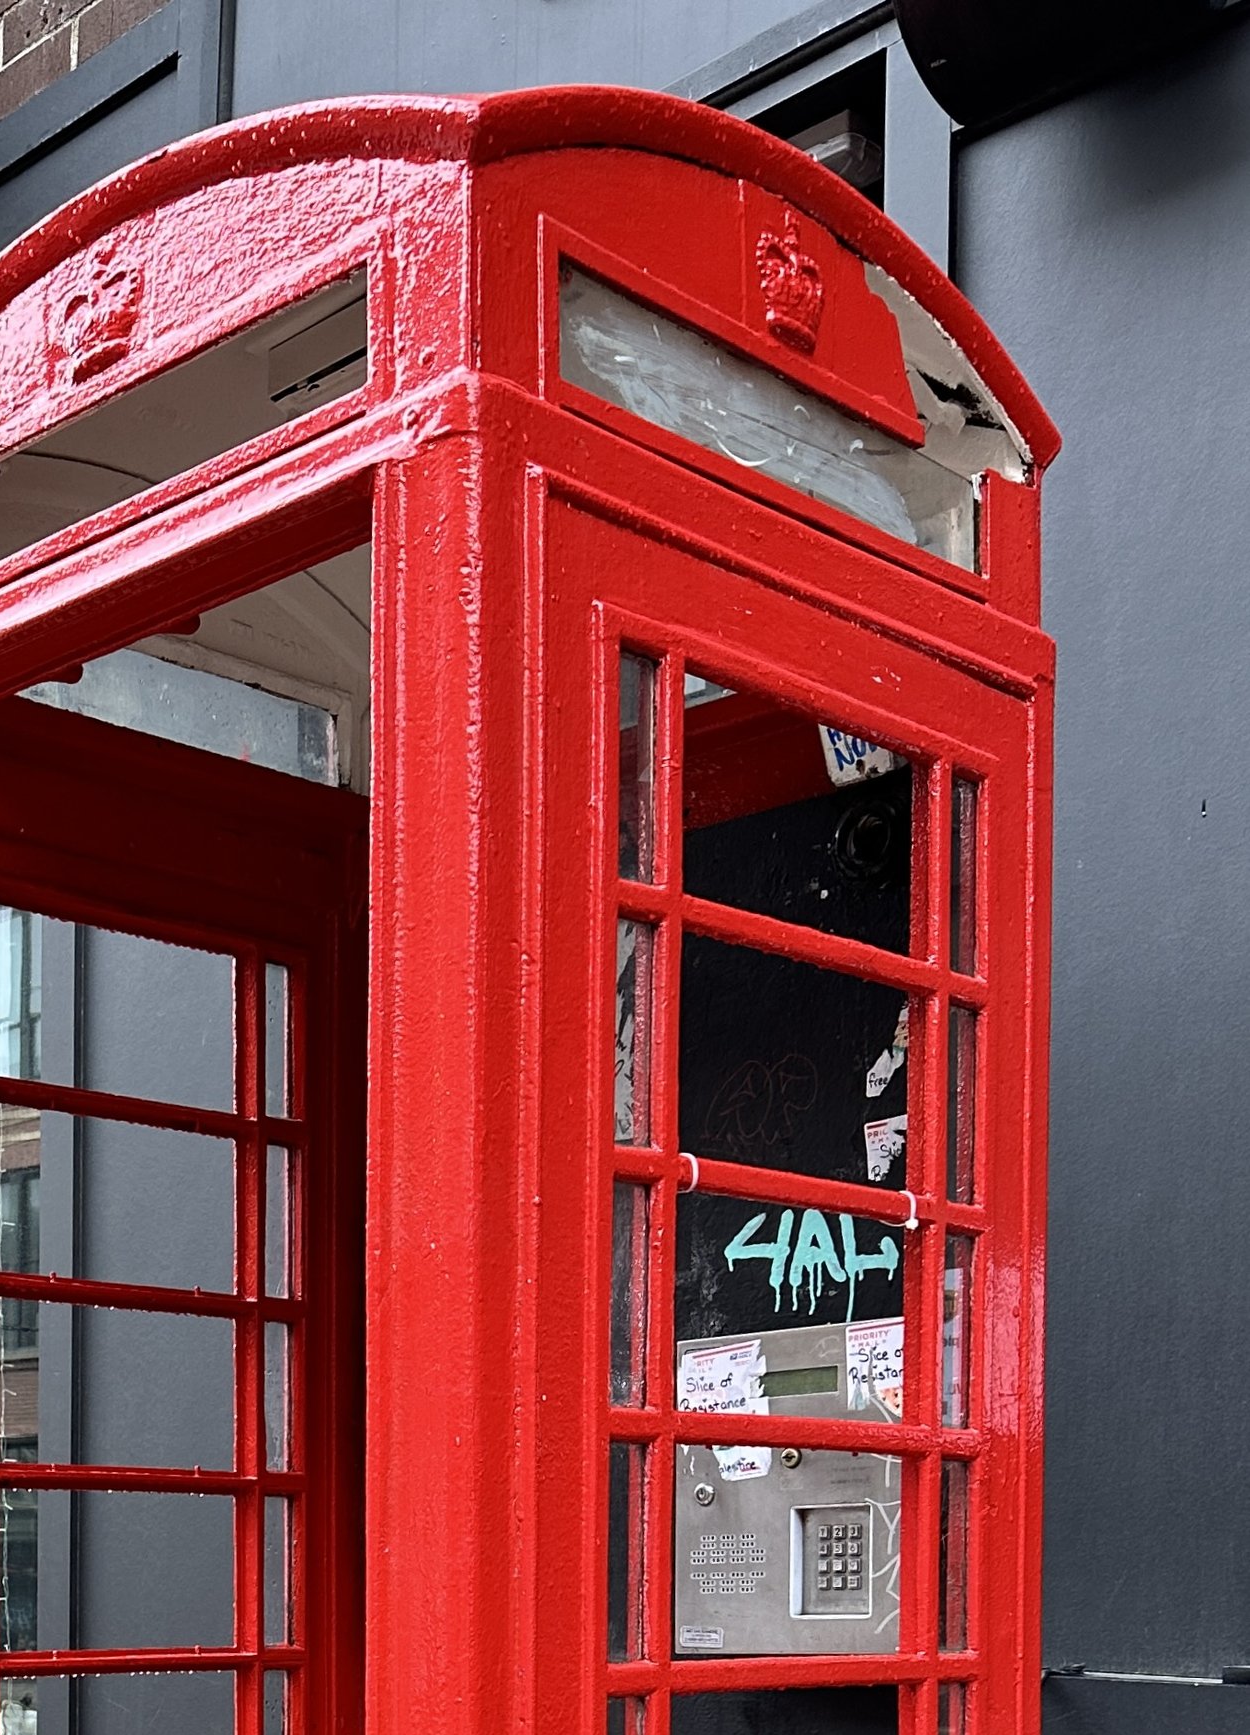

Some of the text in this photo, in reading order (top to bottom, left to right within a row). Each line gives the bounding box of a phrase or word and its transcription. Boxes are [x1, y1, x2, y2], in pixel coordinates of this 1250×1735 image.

[848, 1329, 890, 1342] PRIORITY
[894, 1348, 904, 1358] o
[686, 1372, 733, 1393] Slice of
